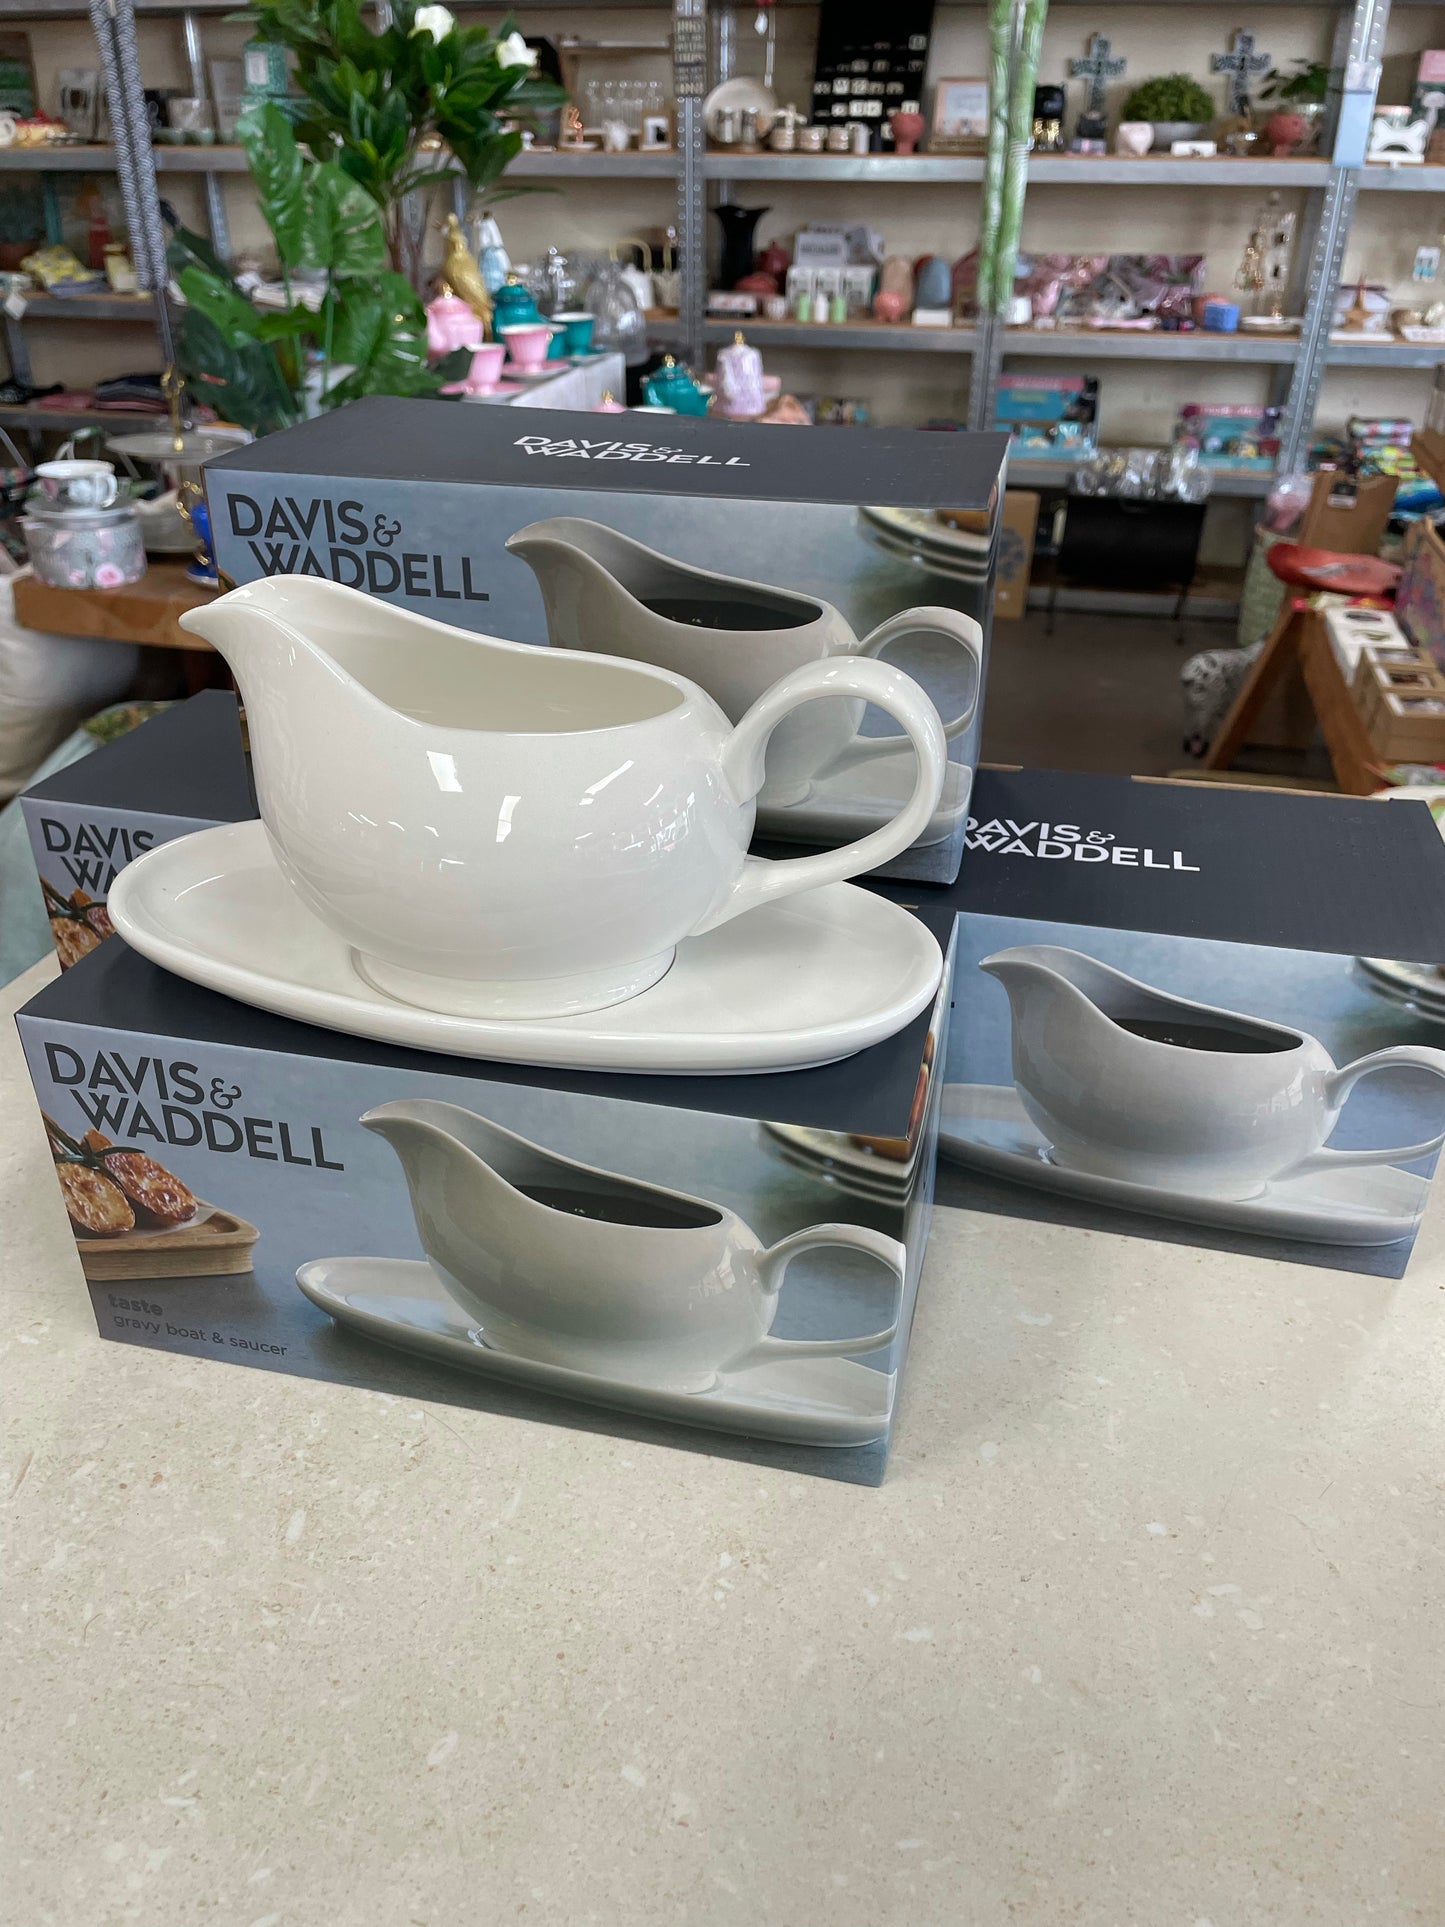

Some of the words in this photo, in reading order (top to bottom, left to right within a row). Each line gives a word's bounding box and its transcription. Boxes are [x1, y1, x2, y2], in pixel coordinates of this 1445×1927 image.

[524, 445, 751, 466] WADDELL
[247, 540, 490, 601] WADDELL
[69, 1088, 345, 1172] WADDELL
[108, 1293, 163, 1317] taste
[113, 1314, 161, 1334] gravy
[166, 1322, 206, 1341] boat
[212, 1332, 224, 1345] &
[230, 1336, 288, 1356] saucer
